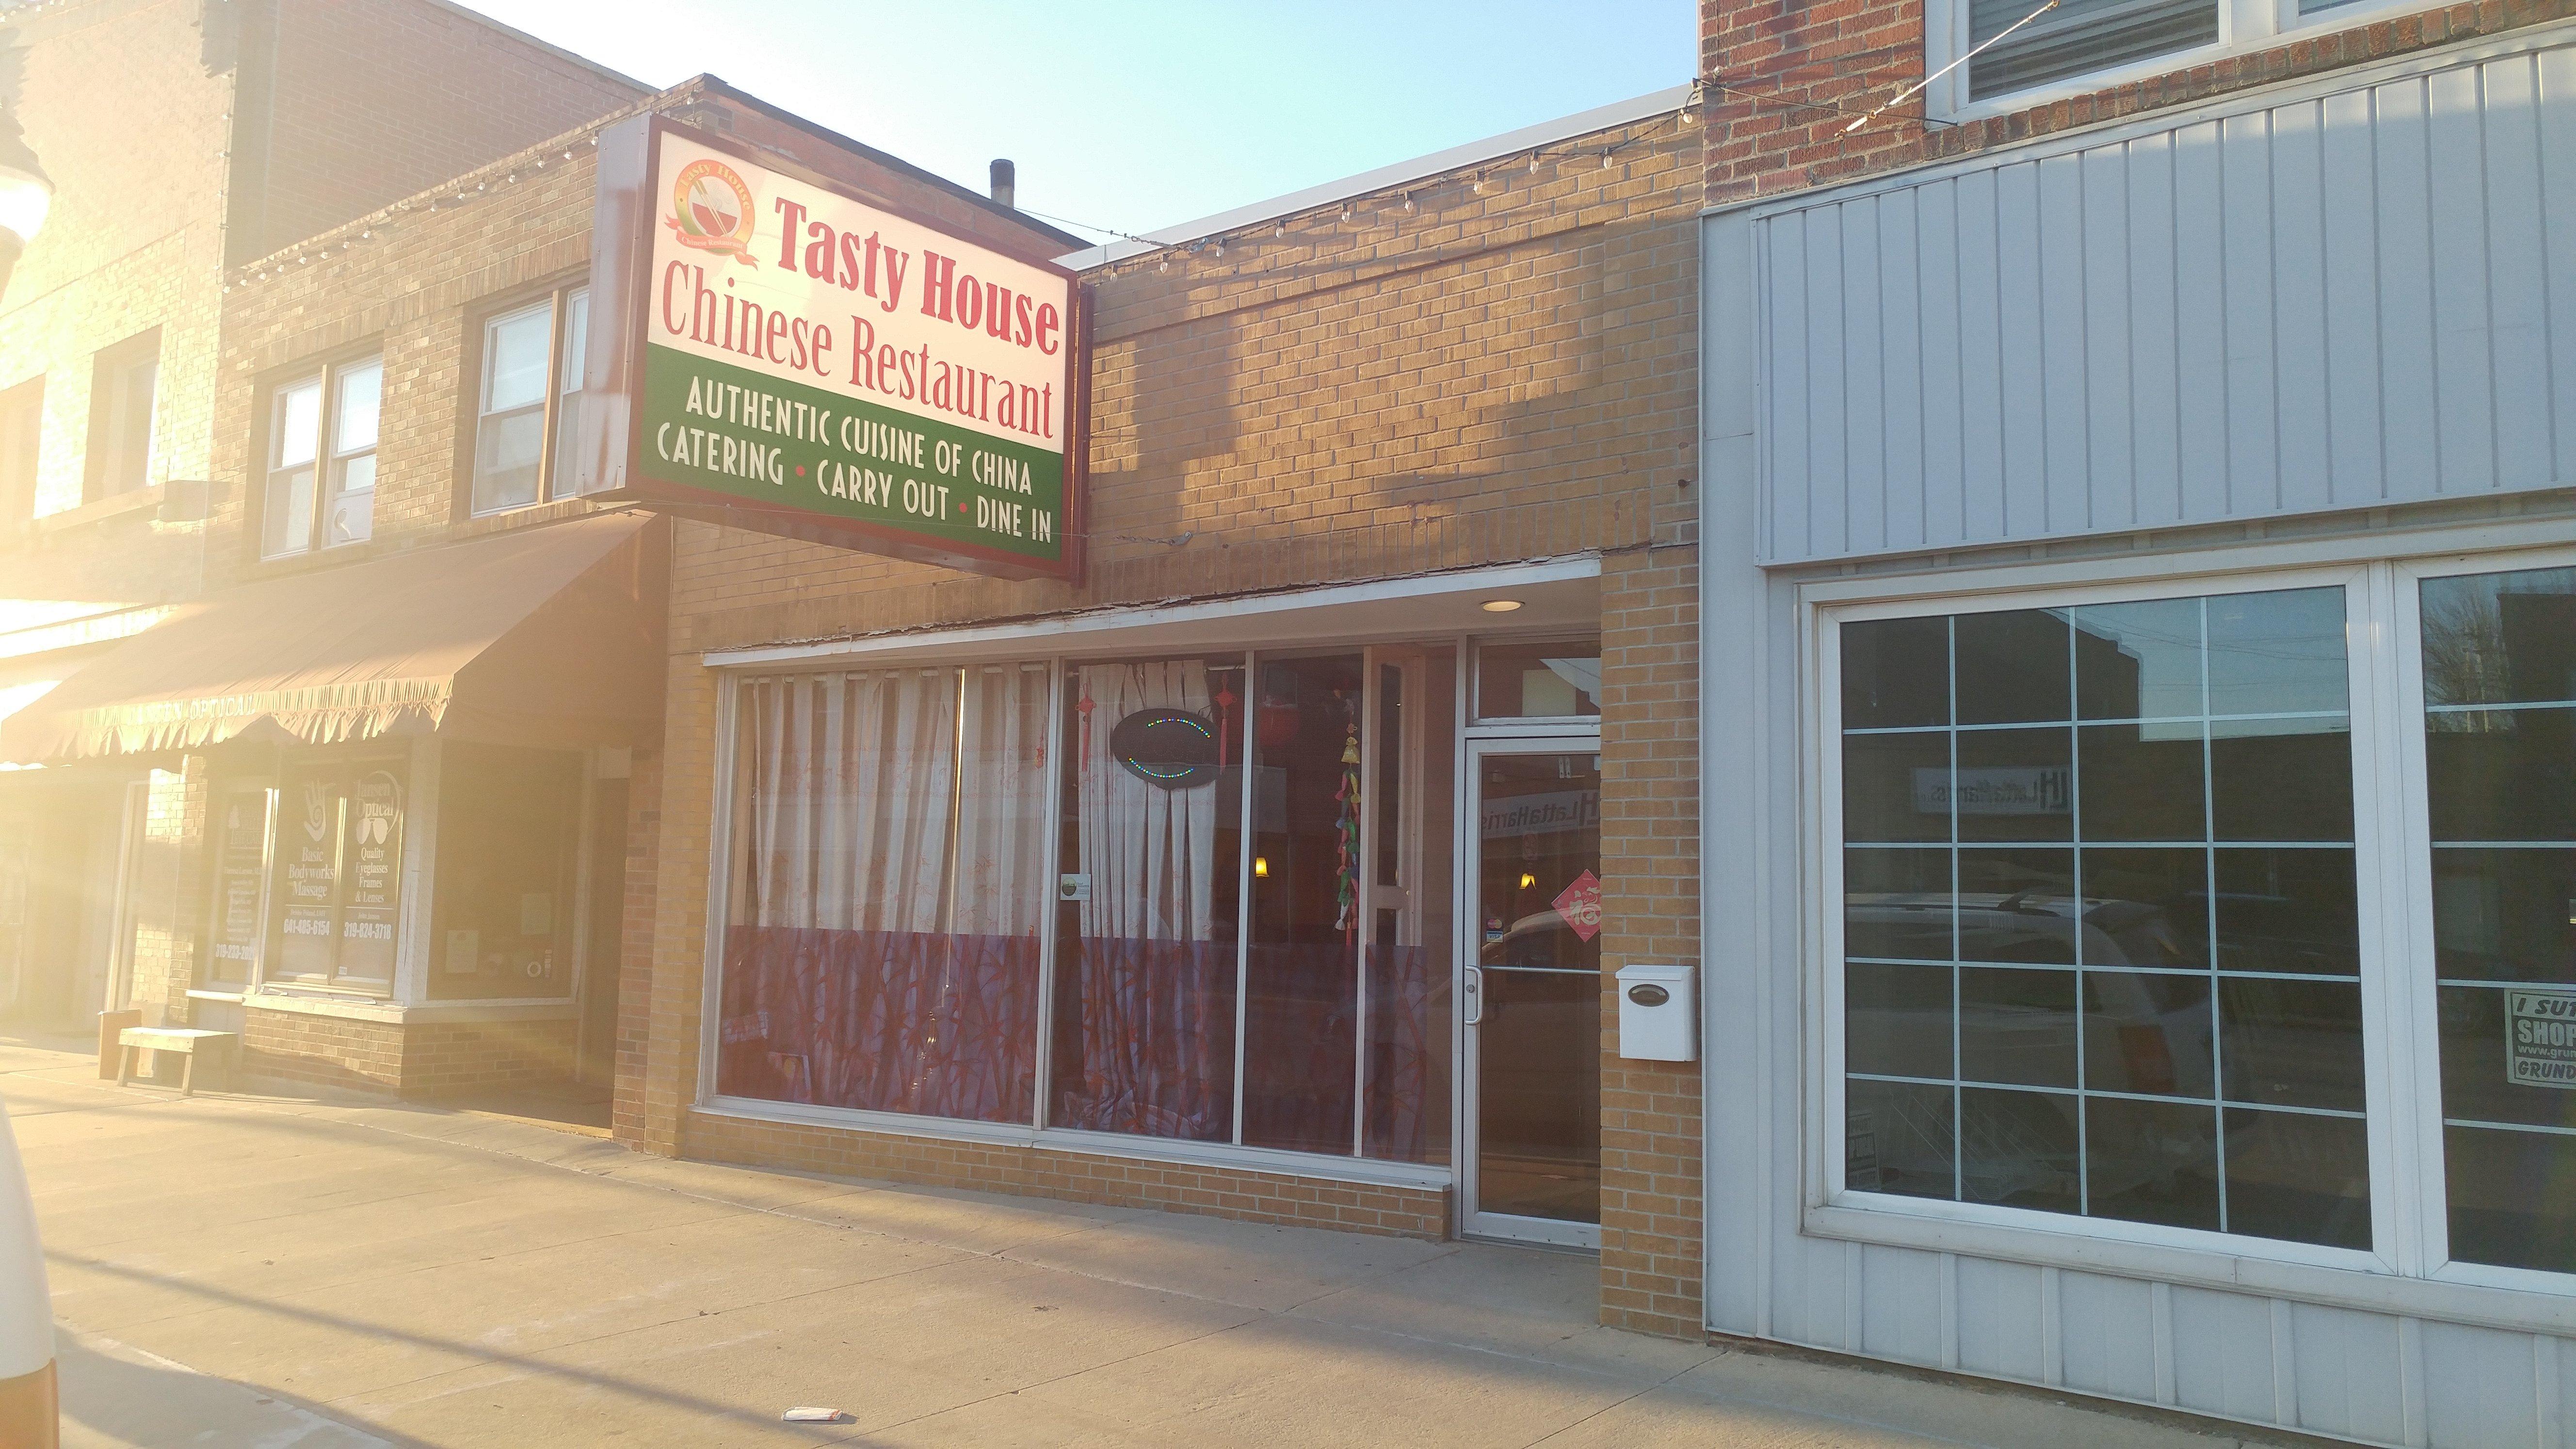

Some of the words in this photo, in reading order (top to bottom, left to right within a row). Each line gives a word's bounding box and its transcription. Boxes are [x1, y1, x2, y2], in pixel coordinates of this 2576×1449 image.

[679, 163, 712, 188] Tasty
[717, 165, 751, 211] House
[681, 236, 707, 246] Chinese
[708, 239, 743, 249] Restaurant
[775, 196, 909, 313] Tasty
[921, 251, 1058, 355] House
[663, 259, 832, 376] Chinese
[849, 315, 1054, 438] Restaurant
[685, 375, 831, 446] AUTHENTIC
[841, 416, 924, 469] CUISINE
[935, 440, 962, 477] OF
[972, 451, 1032, 495] CHINA
[658, 421, 783, 485] CATERING
[818, 459, 892, 508] CARRY
[903, 480, 949, 520] OUT
[977, 496, 1022, 537] DINE
[1032, 509, 1051, 544] IN
[356, 797, 394, 819] Optical
[302, 847, 323, 862] Basic
[361, 847, 385, 861] Quality
[288, 864, 335, 883] Bodyworks
[355, 862, 388, 876] Eyeglasses
[292, 880, 328, 900] Massage
[359, 876, 383, 888] Frames
[355, 893, 361, 902] &
[363, 891, 385, 903] Lenses
[343, 922, 392, 940] 319-824-3718
[2516, 998, 2527, 1013] I
[2517, 1019, 2576, 1046] SHOP
[2518, 1061, 2576, 1079] GRUND
